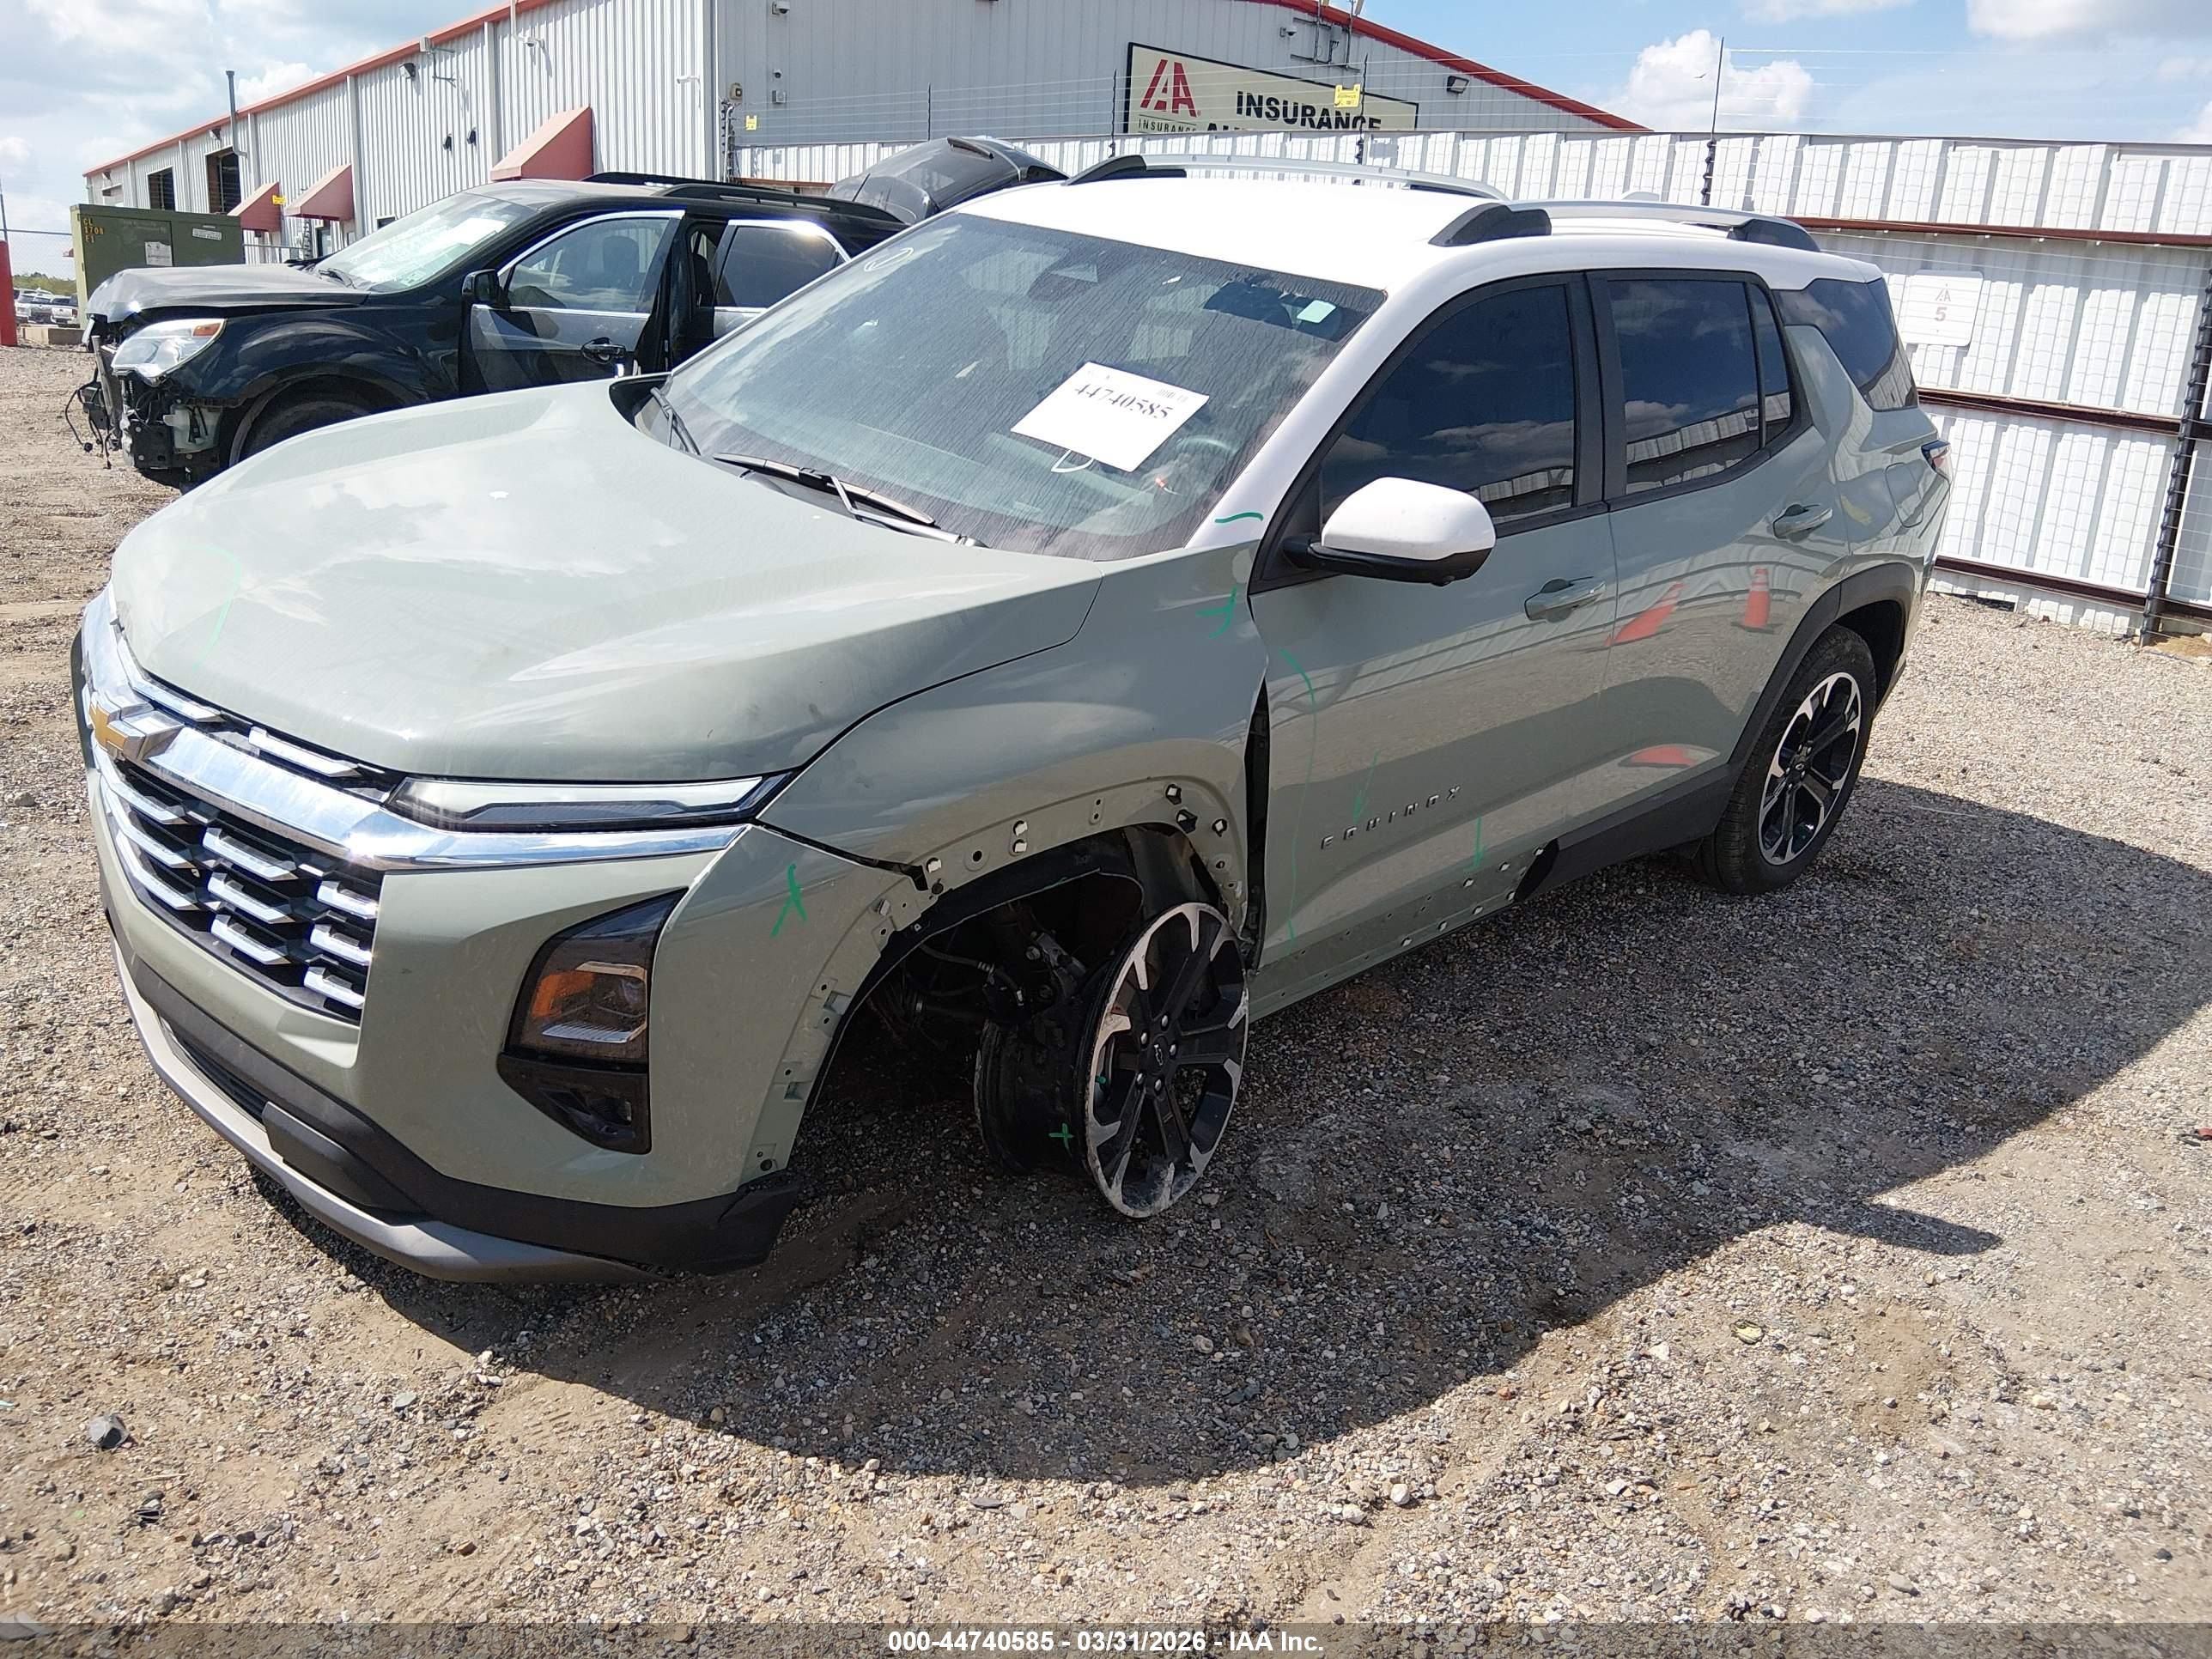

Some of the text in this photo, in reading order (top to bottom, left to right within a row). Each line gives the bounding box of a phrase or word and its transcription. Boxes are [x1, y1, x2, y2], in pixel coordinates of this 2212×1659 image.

[1138, 119, 1197, 132] INSURAN
[1934, 306, 1948, 322] 5
[1074, 384, 1174, 418] 44740585
